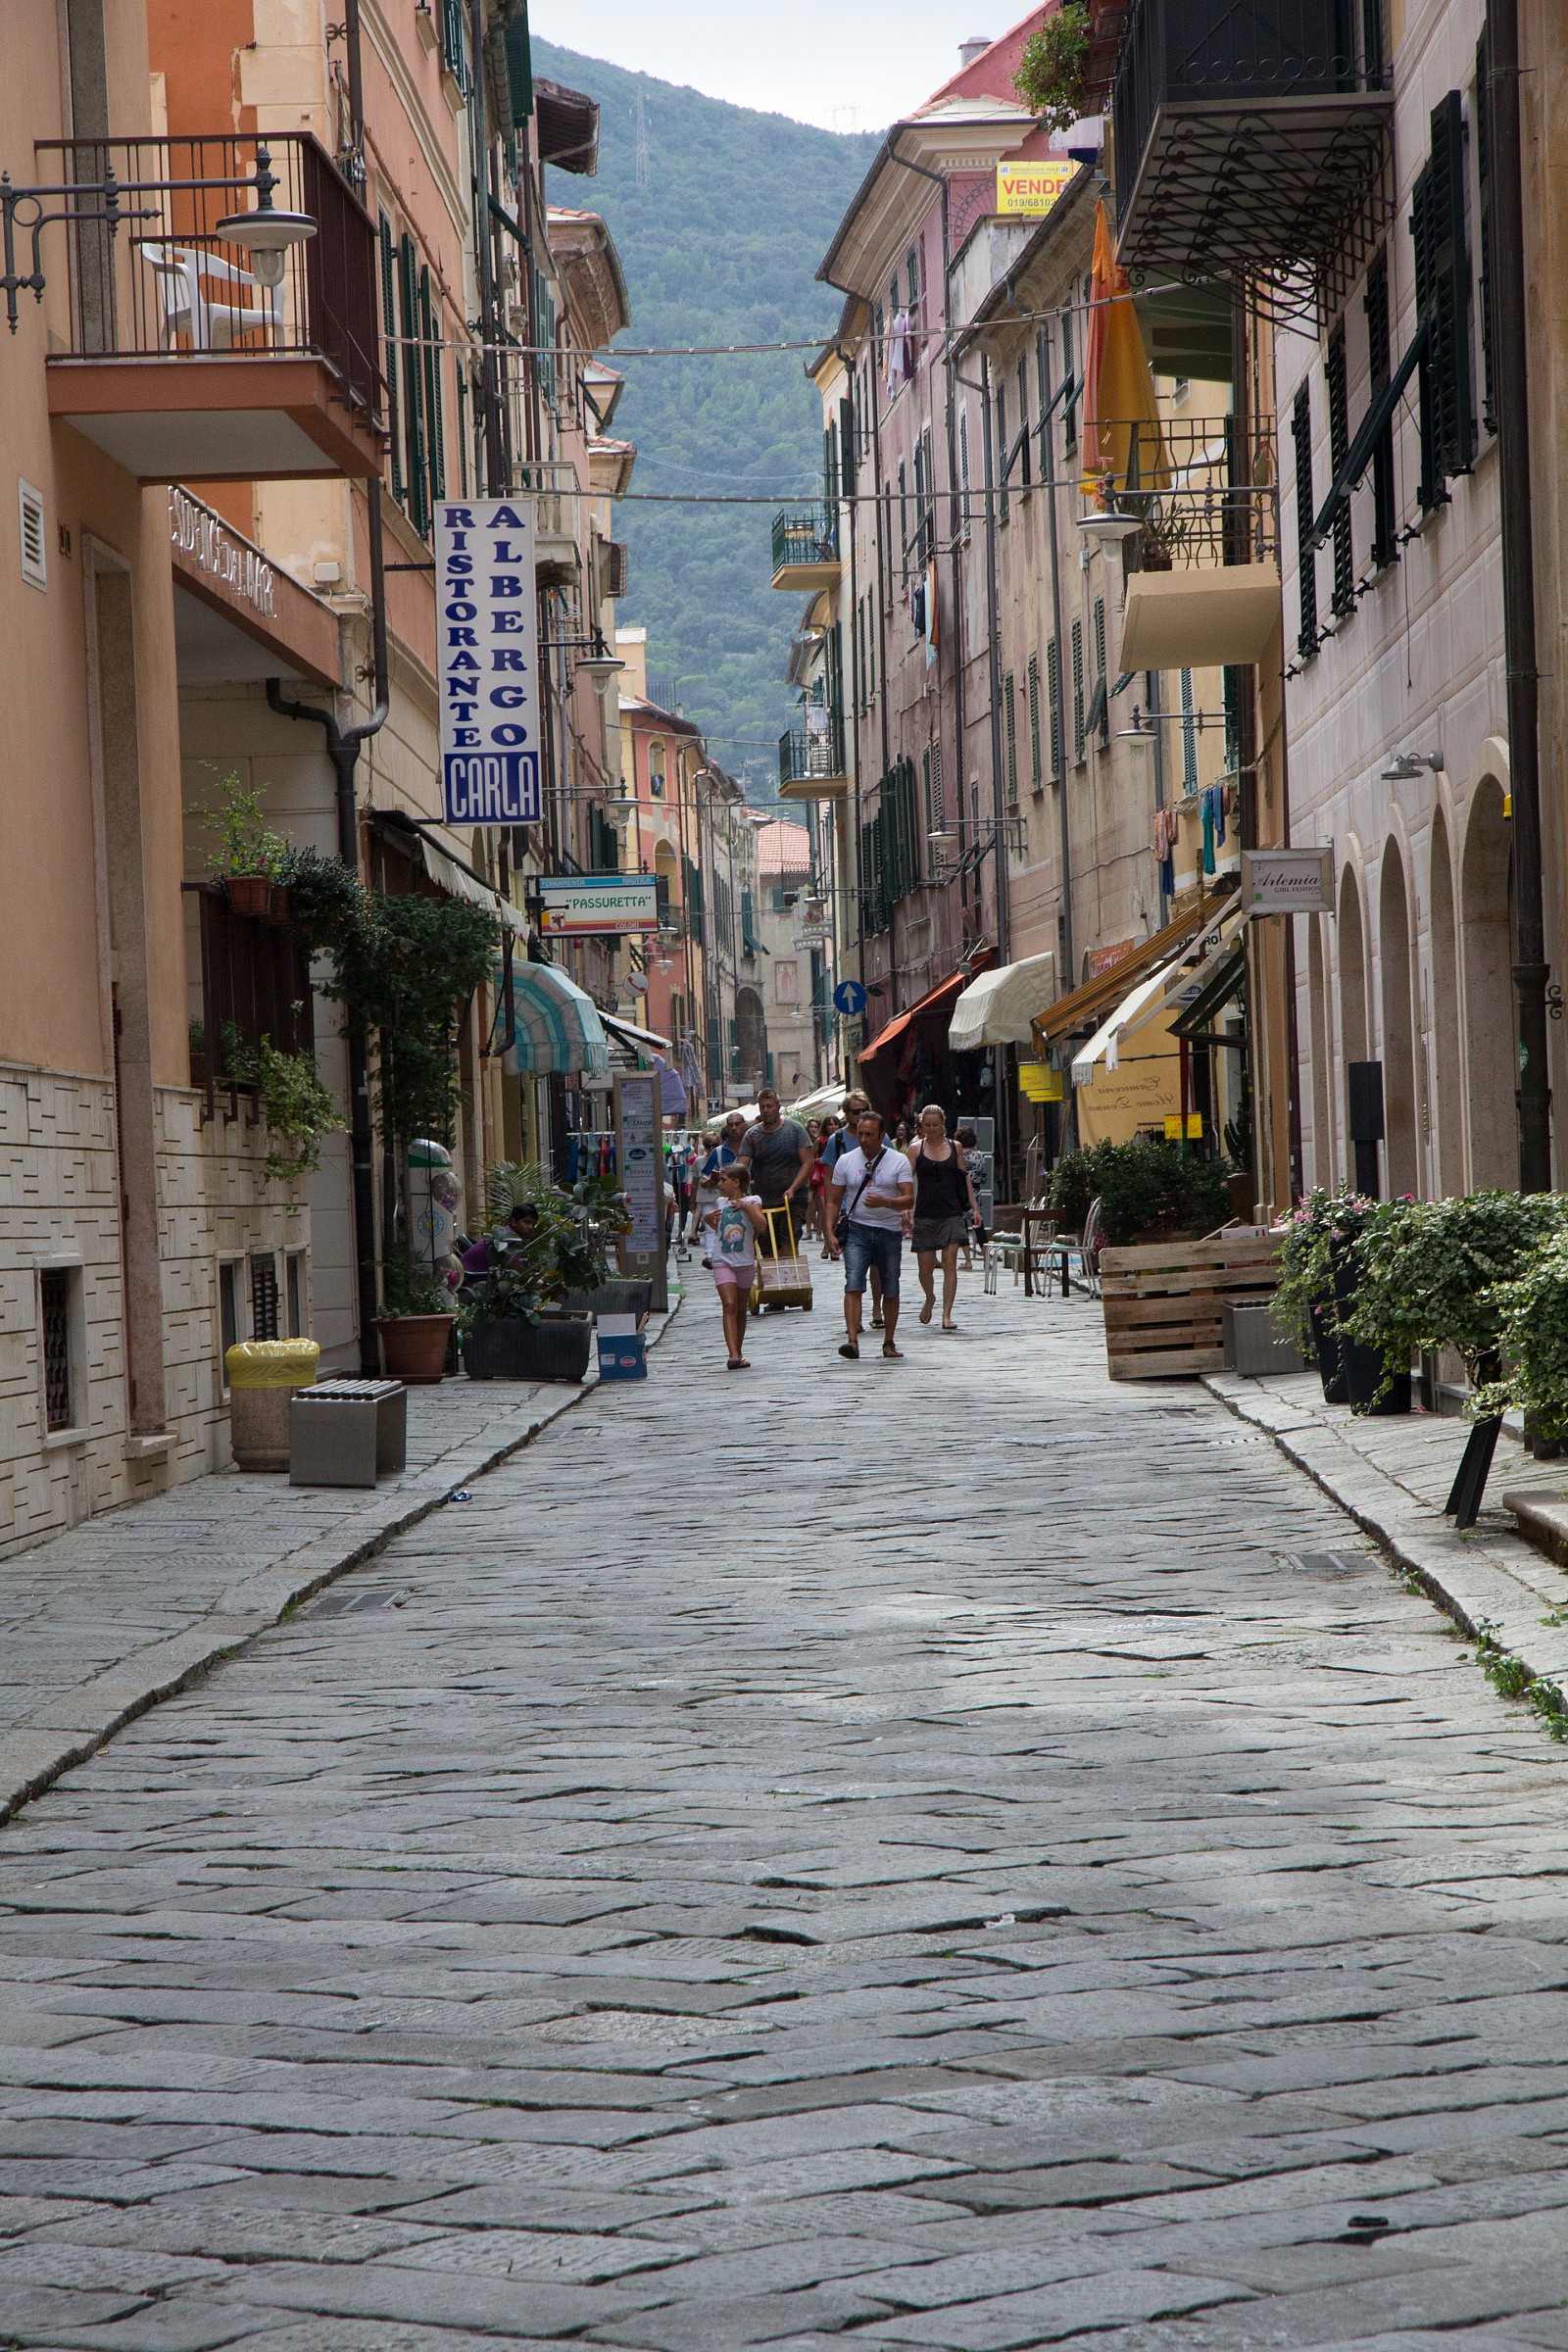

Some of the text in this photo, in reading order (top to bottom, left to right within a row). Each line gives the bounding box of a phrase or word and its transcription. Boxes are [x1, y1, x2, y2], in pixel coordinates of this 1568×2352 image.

[444, 508, 482, 748] RISTORANTE
[486, 505, 527, 747] ALBERGO
[450, 756, 535, 819] CARLA
[1251, 872, 1321, 887] Artemia
